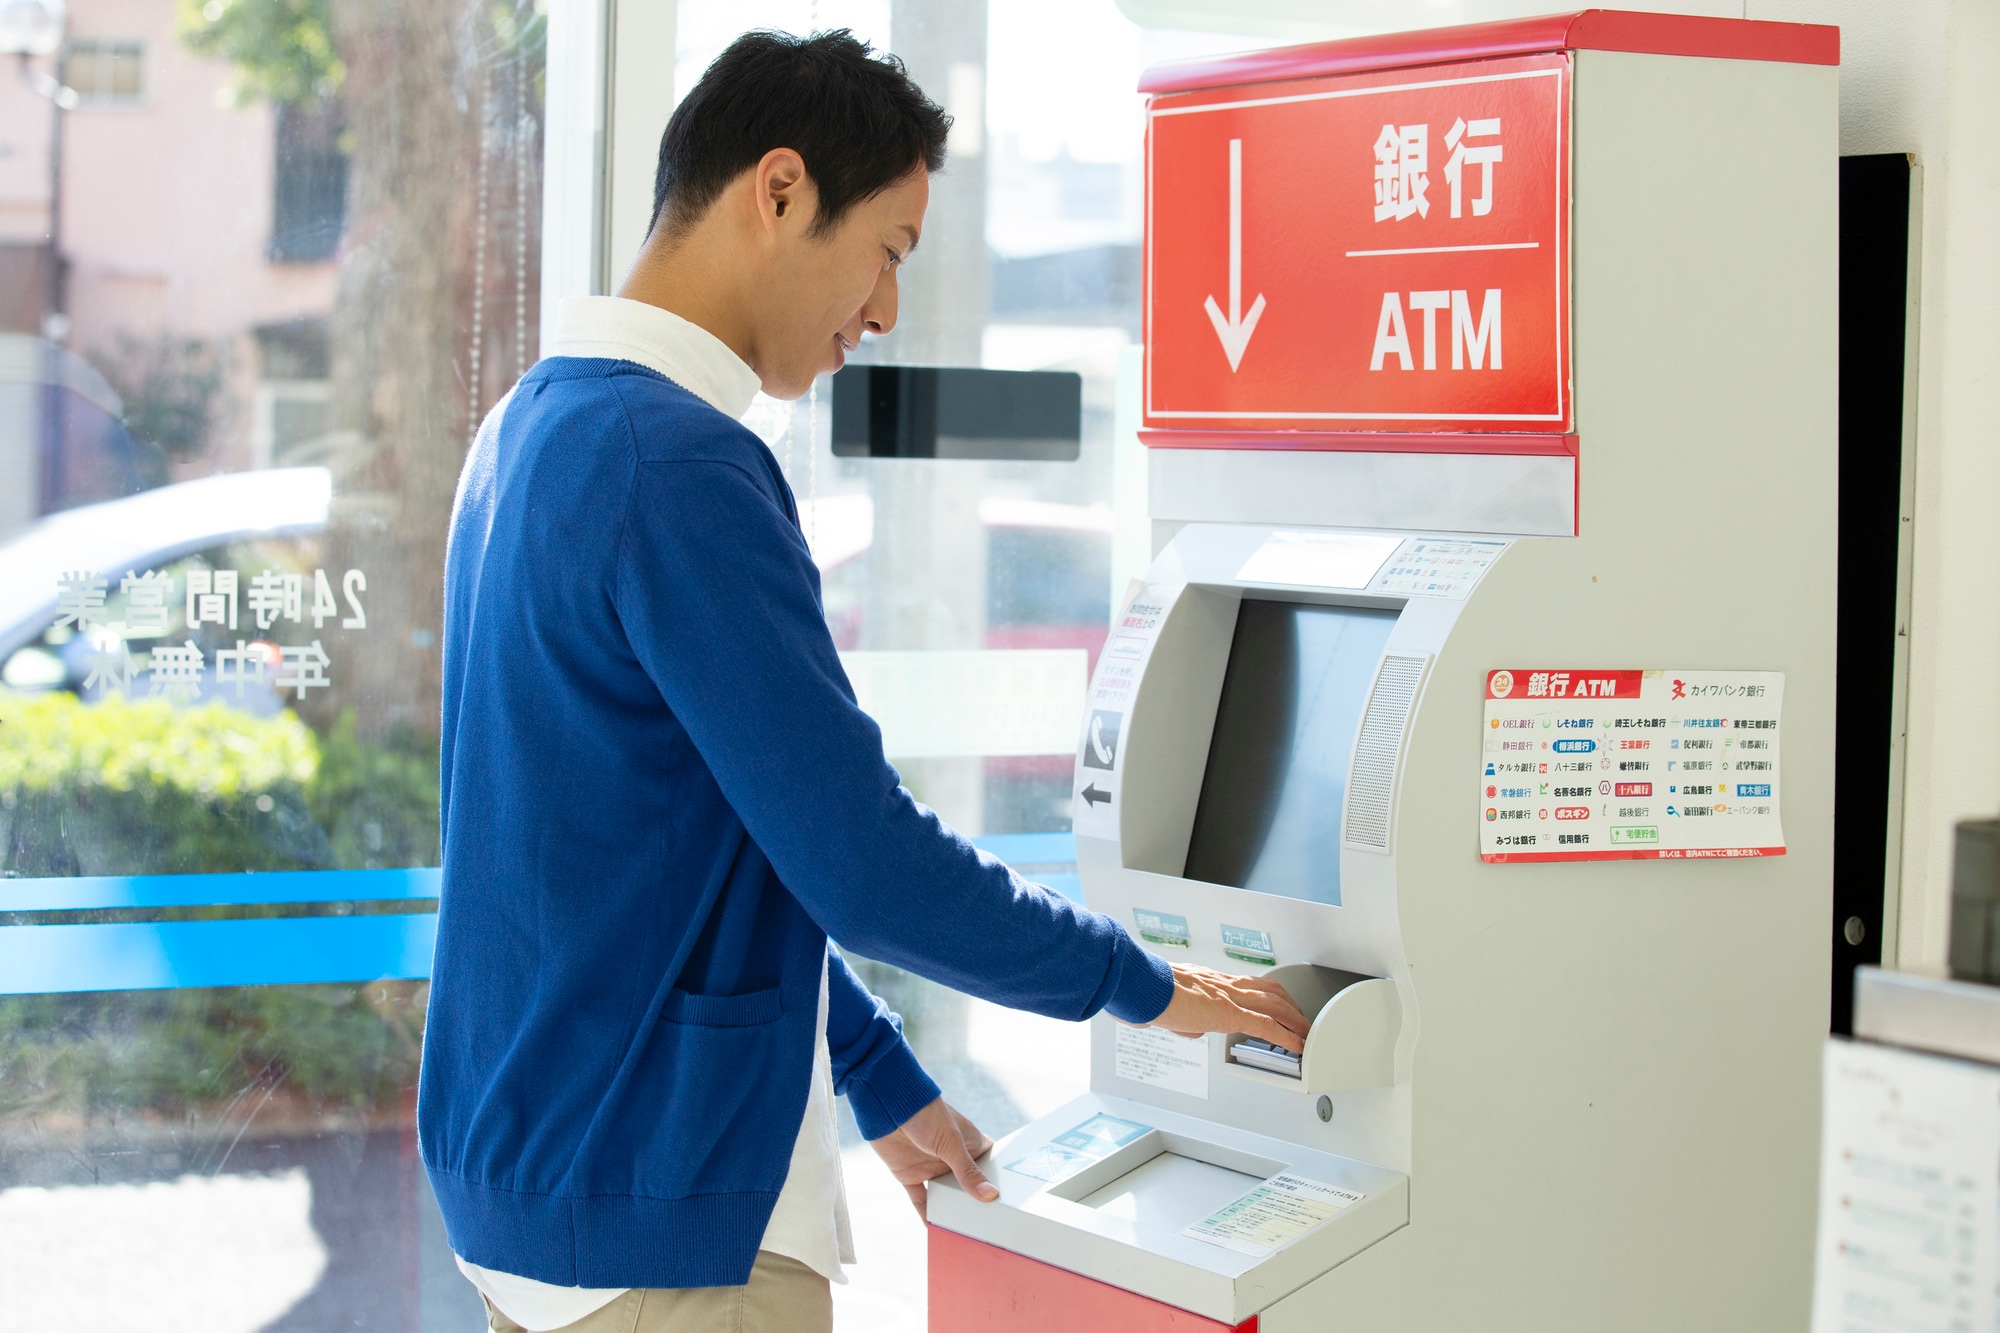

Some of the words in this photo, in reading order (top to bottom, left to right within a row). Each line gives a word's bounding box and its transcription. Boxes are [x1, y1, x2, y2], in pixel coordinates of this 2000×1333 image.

[1373, 116, 1503, 223] 銀行
[1369, 289, 1503, 371] ATM
[1495, 677, 1508, 686] 24
[1527, 672, 1570, 697] 銀行
[1573, 679, 1617, 697] ATM
[1691, 684, 1765, 697] カイワバンク銀行
[1557, 719, 1594, 728] しそね銀行
[1554, 762, 1593, 772] 八十三銀行
[1619, 784, 1649, 795] 十八銀行
[1496, 835, 1537, 846] みづは銀行
[1224, 930, 1246, 943] カード
